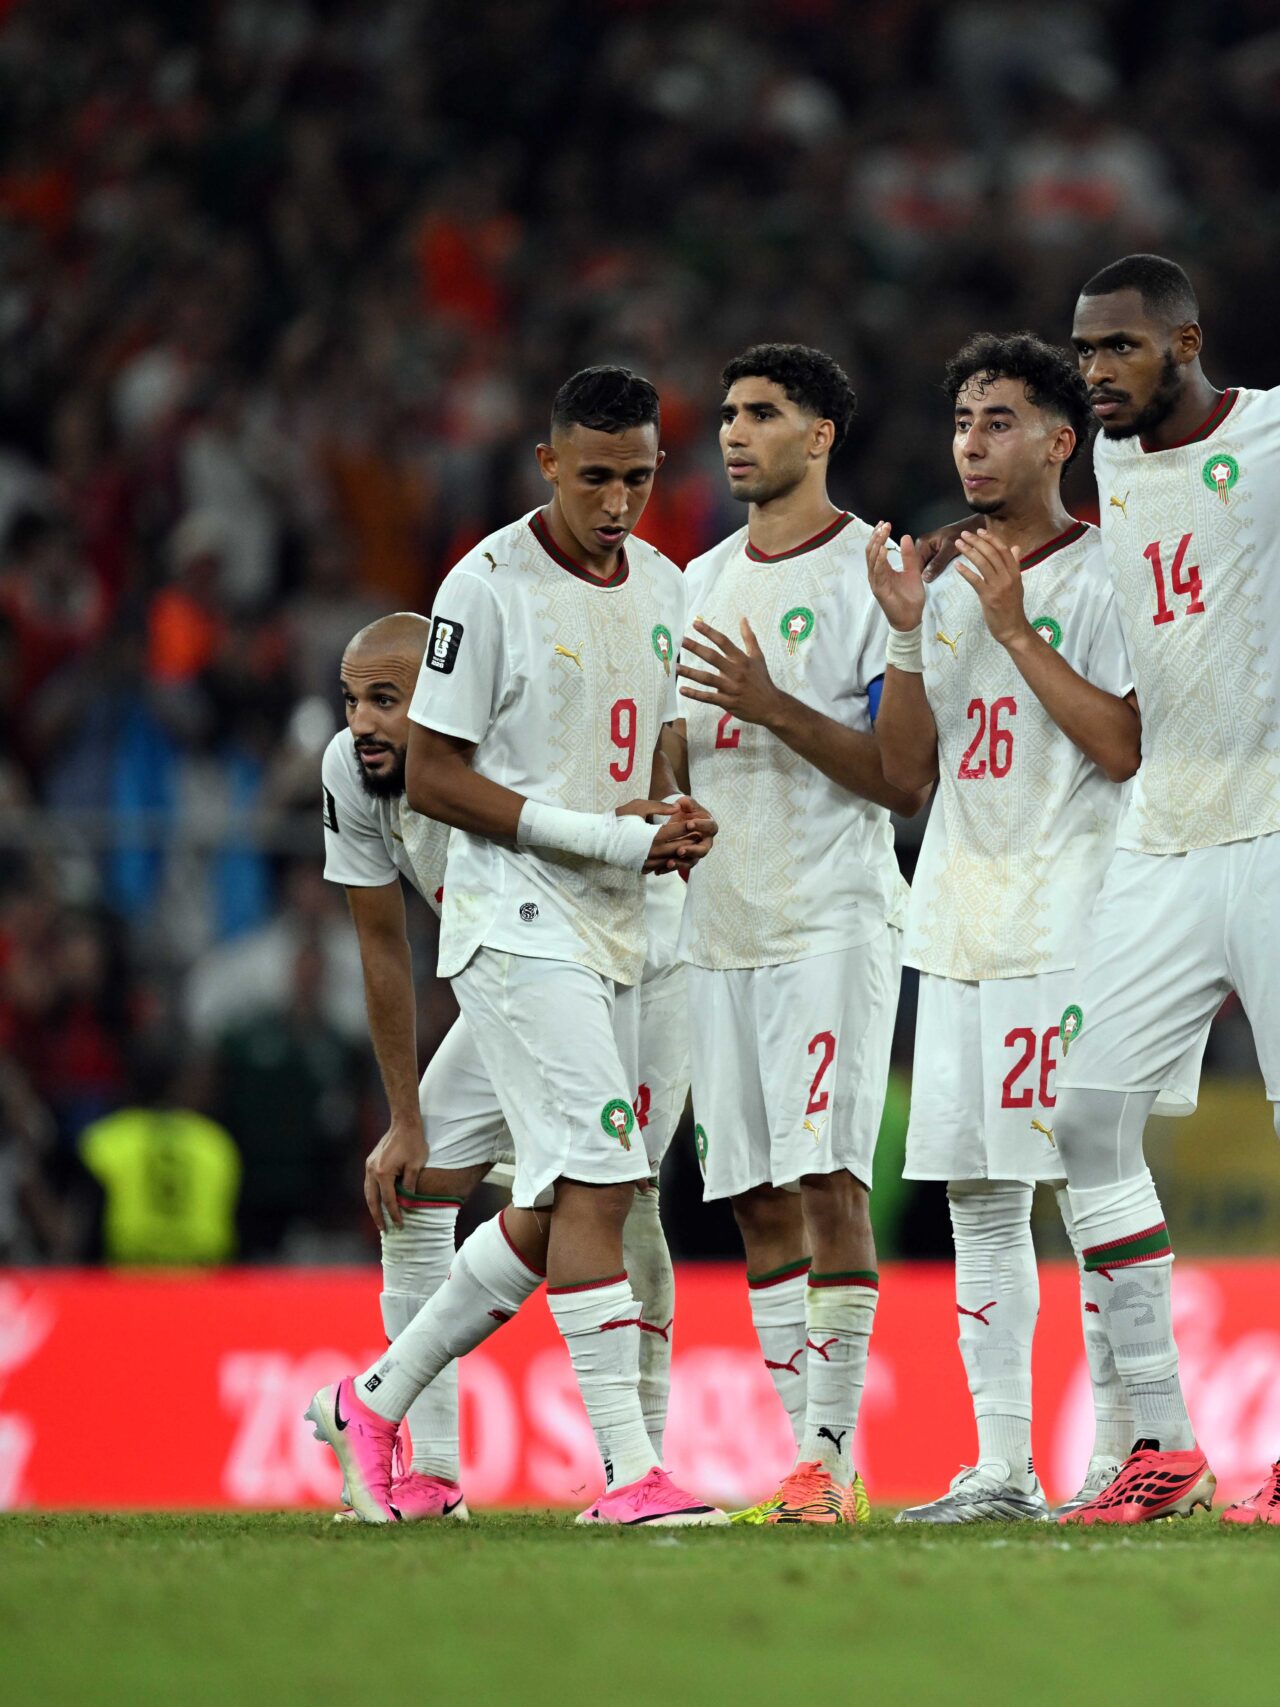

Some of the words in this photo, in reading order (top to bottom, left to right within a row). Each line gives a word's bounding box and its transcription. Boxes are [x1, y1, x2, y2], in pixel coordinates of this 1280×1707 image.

[1142, 533, 1206, 627] 14
[609, 698, 638, 783] 9
[957, 696, 1017, 780] 26
[807, 1031, 836, 1115] 2
[1001, 1026, 1060, 1109] 26
[367, 1379, 379, 1390] FS
